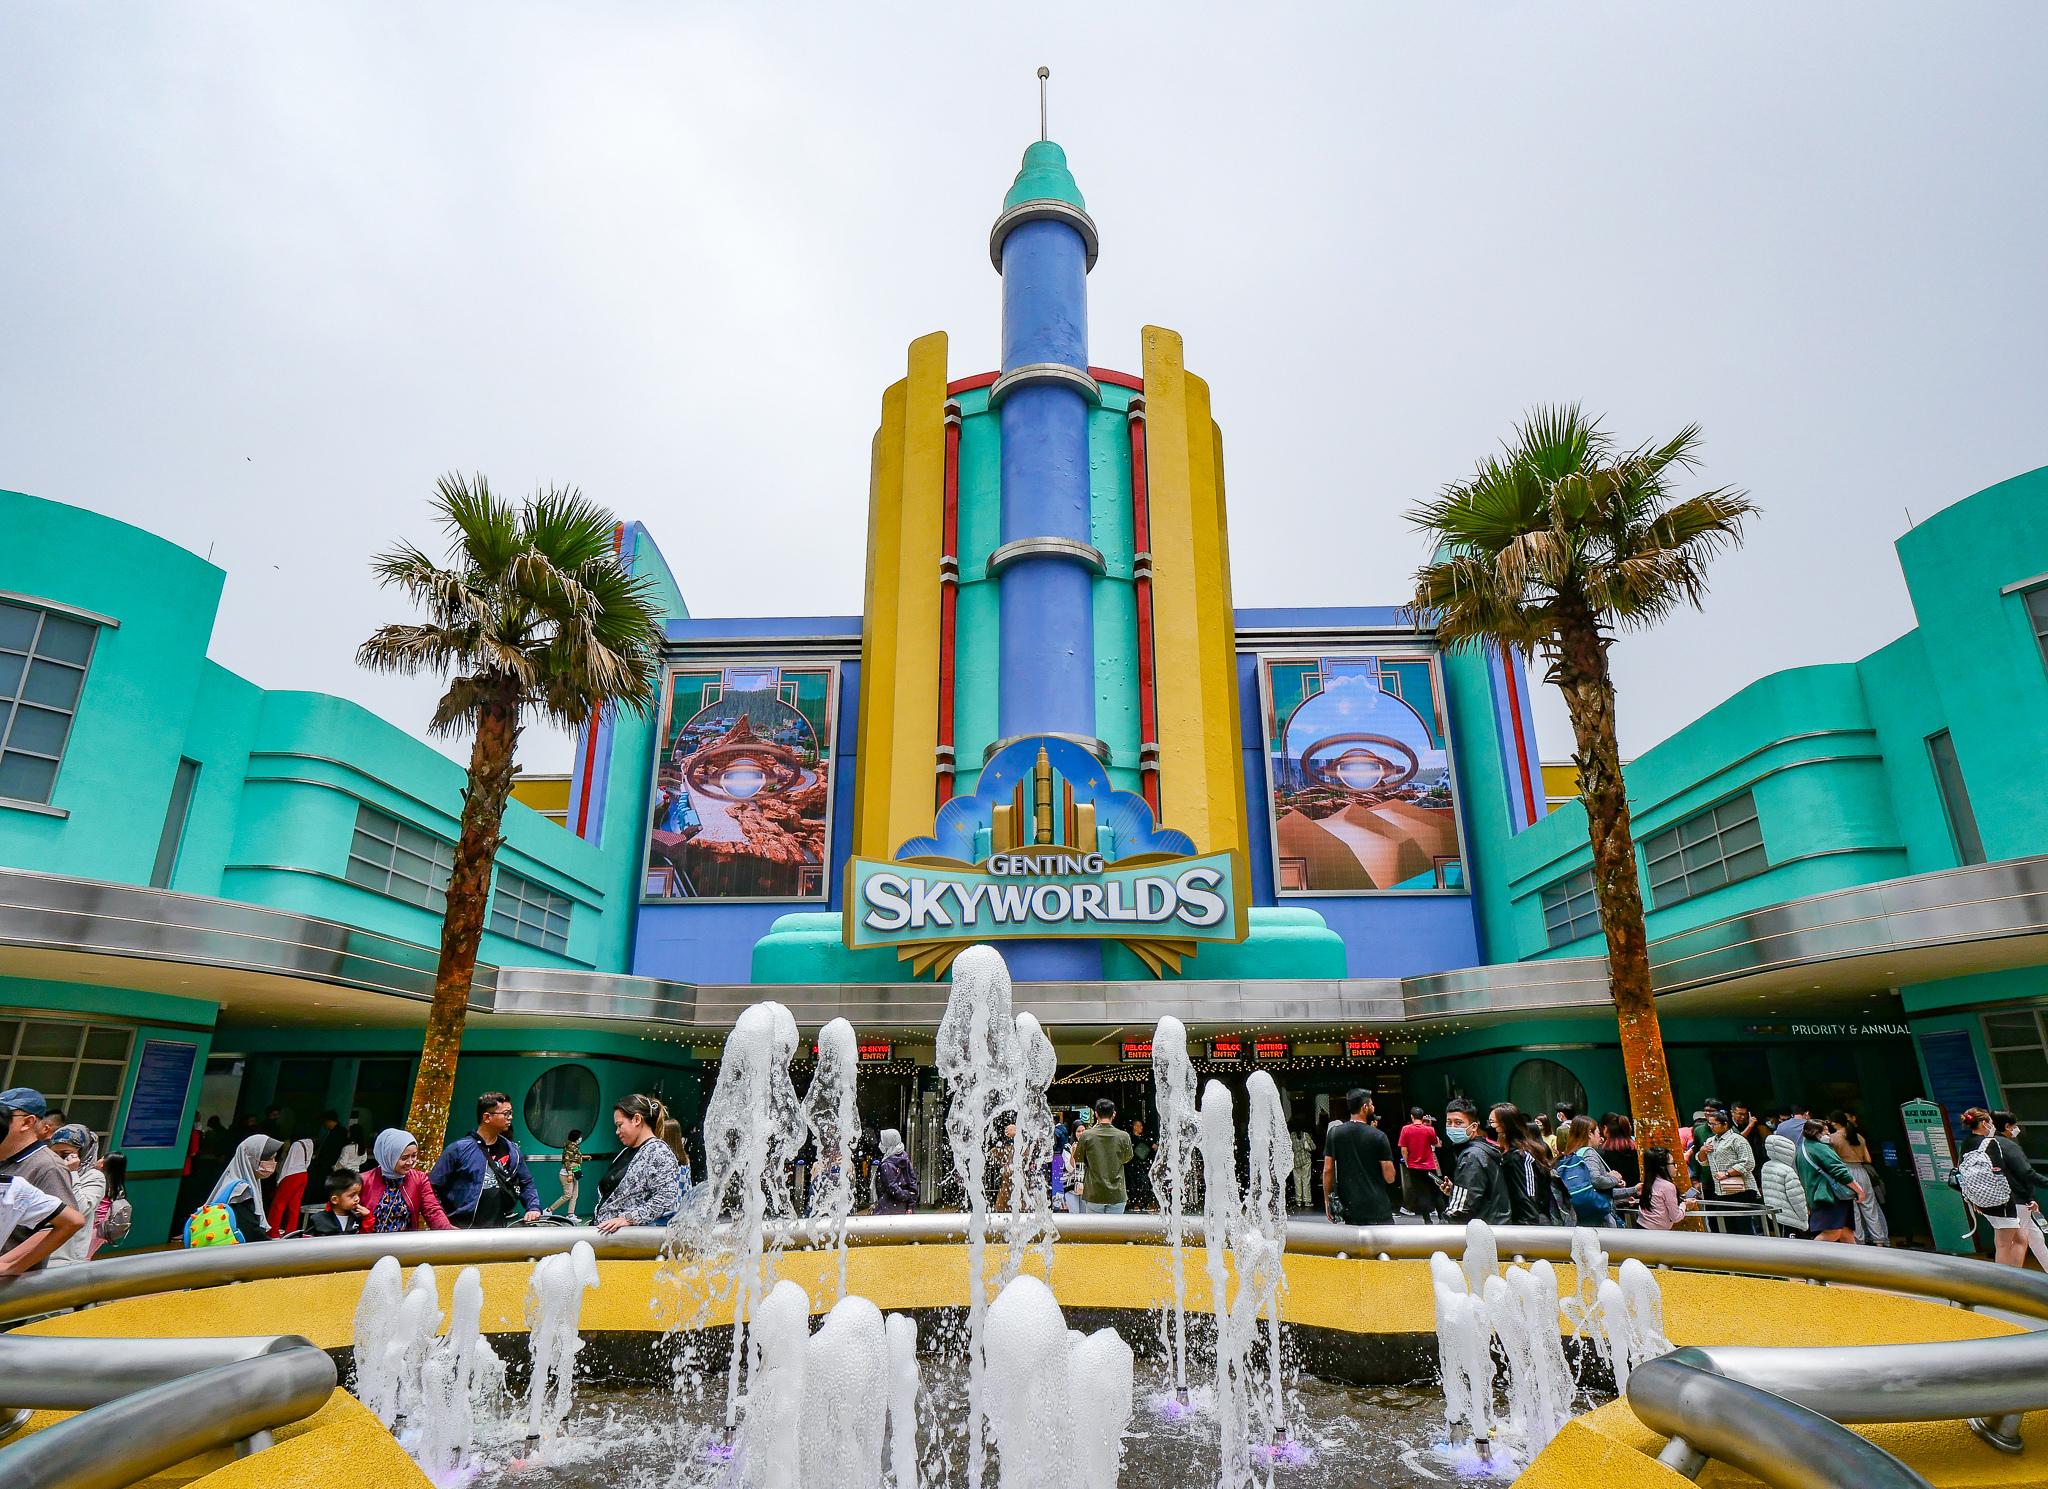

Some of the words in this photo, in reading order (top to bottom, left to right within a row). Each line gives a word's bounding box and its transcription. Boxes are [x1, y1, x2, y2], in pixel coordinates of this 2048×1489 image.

[986, 852, 1104, 876] GENTING
[864, 868, 1225, 930] SKYWORLDS
[1791, 1024, 1846, 1035] PRIORITY
[1849, 1024, 1858, 1034] &
[1861, 1024, 1911, 1035] ANNUAL
[1213, 1050, 1237, 1058] ENTRY
[1259, 1050, 1284, 1058] ENTRY
